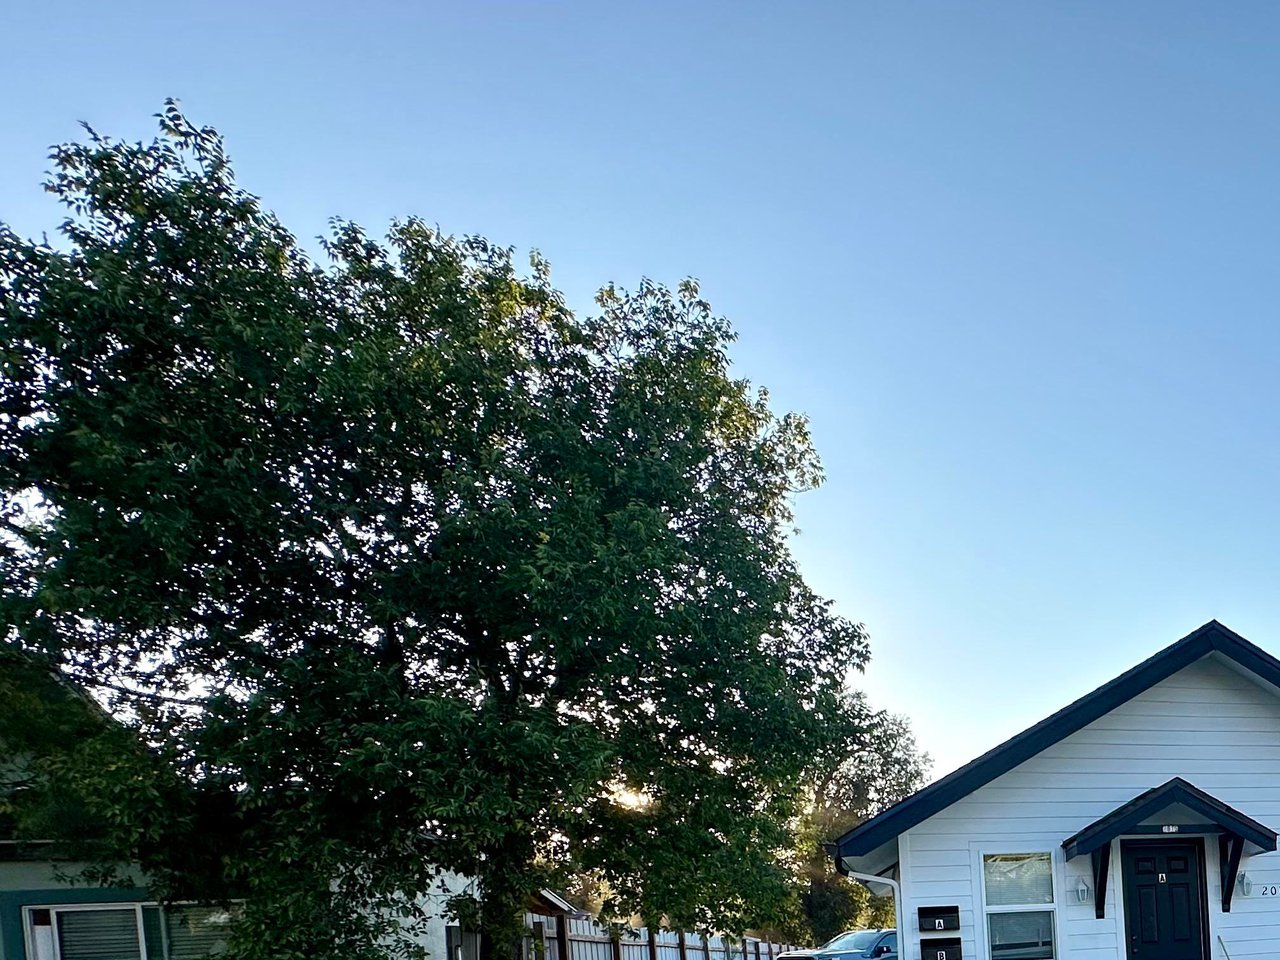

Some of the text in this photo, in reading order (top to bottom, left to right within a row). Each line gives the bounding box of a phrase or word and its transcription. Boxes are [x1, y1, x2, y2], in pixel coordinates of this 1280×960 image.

[1160, 874, 1166, 882] A
[936, 920, 943, 929] A
[938, 952, 946, 960] B
